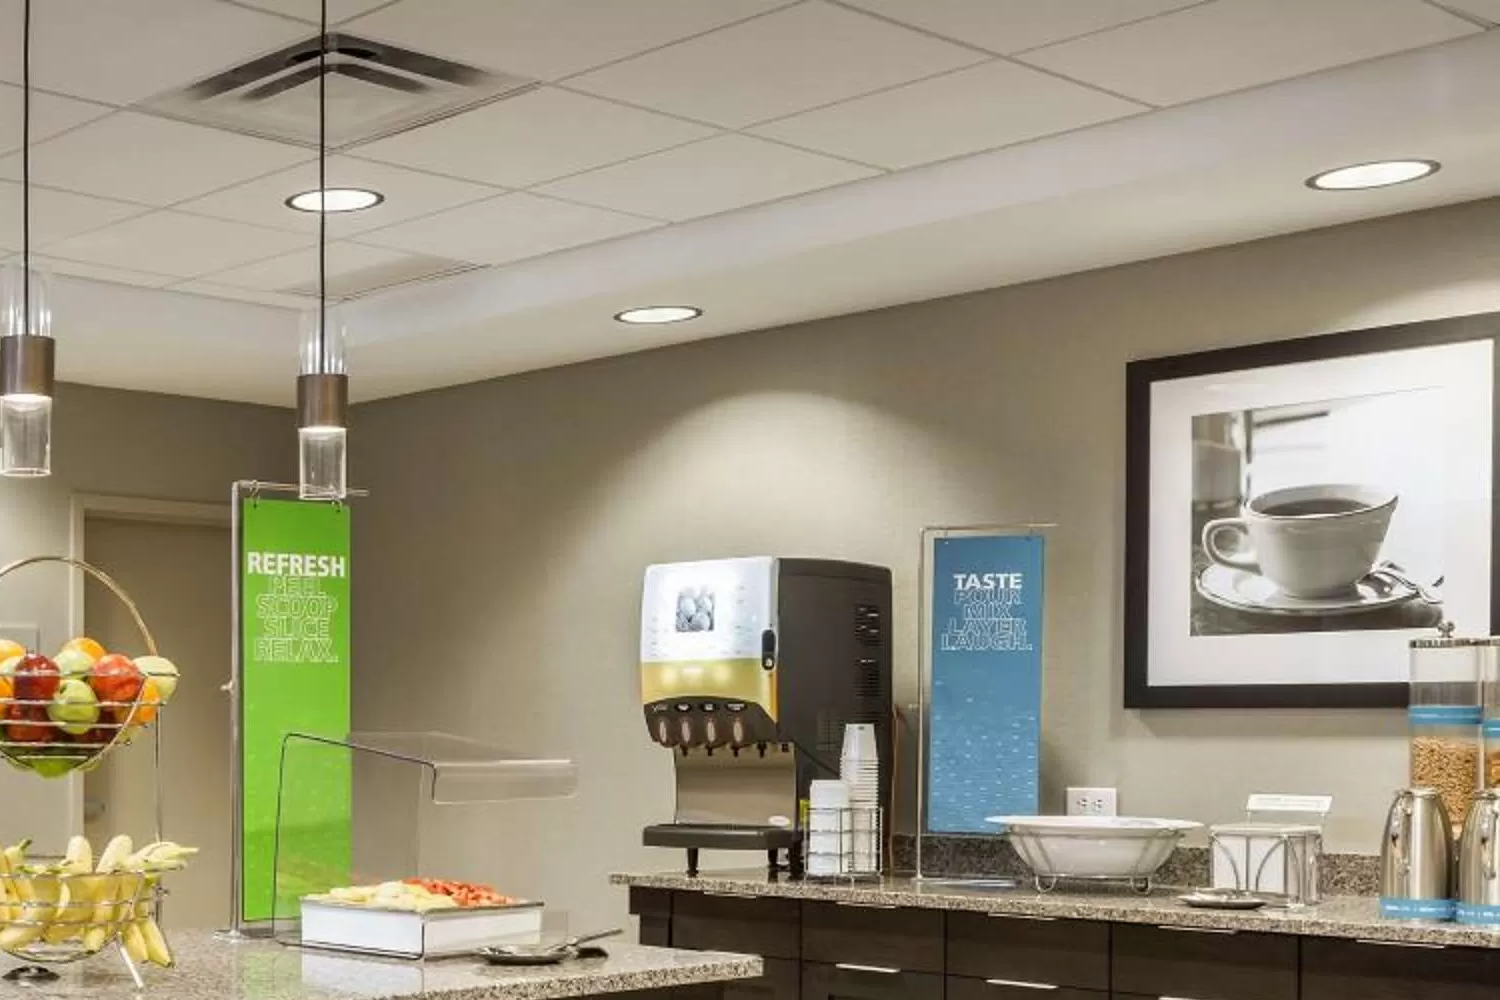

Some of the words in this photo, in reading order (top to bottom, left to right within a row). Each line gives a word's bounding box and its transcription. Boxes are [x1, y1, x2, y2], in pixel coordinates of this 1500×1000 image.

[248, 552, 345, 577] REFRESH
[953, 573, 1023, 590] TASTE
[256, 593, 338, 619] SCOOP
[963, 603, 1012, 620] MIX
[263, 616, 330, 639] SLICE
